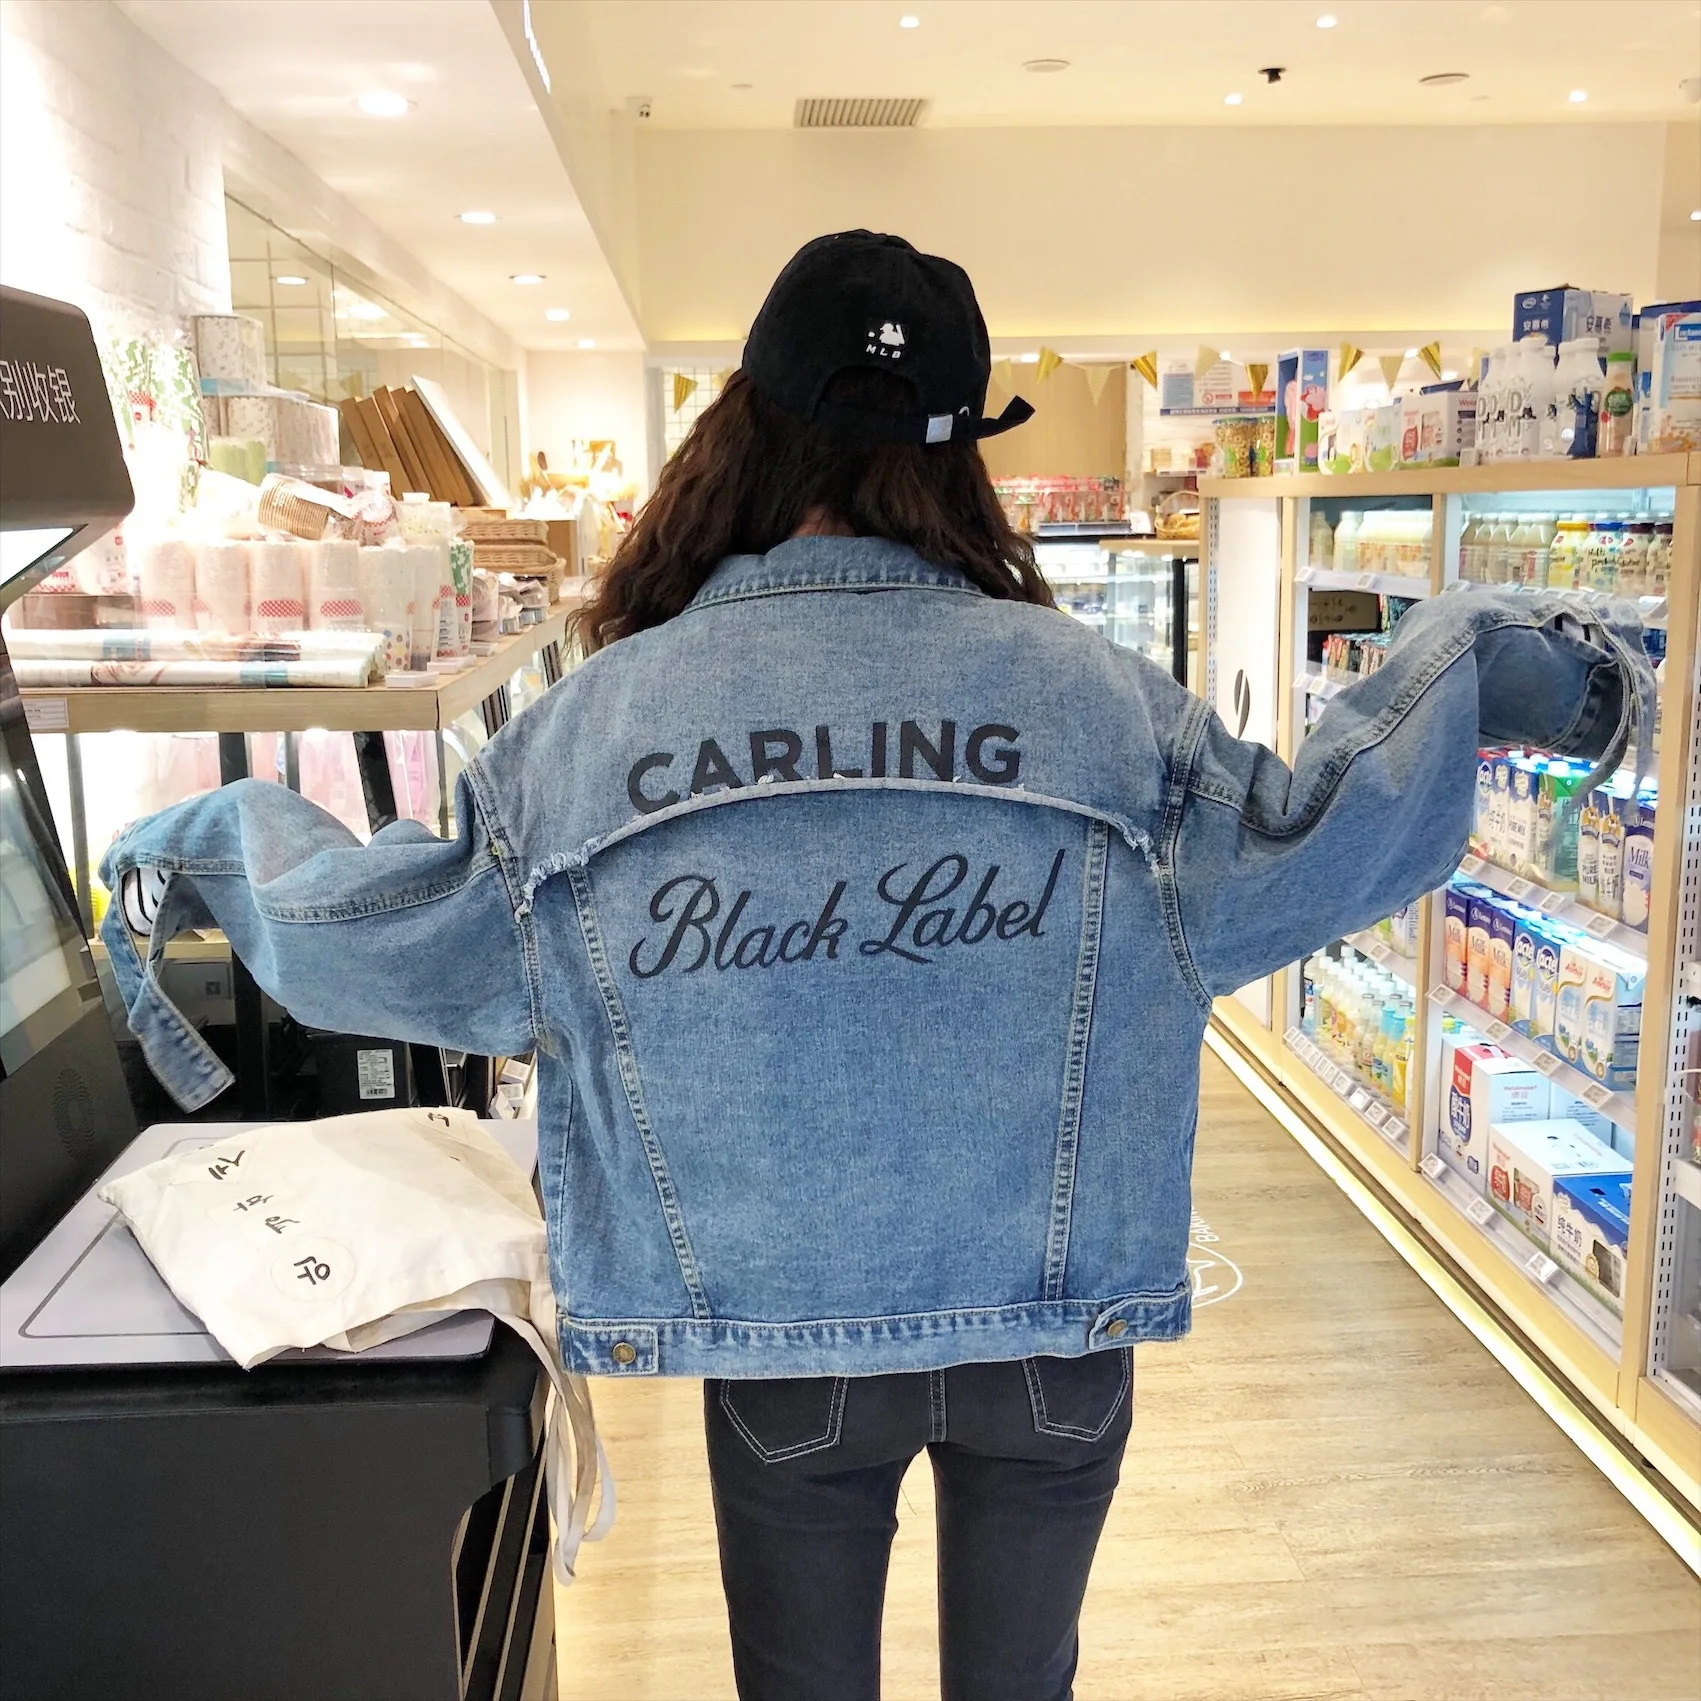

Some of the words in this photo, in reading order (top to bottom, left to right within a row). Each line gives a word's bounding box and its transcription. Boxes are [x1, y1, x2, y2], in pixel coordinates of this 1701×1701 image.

[866, 344, 901, 359] MLB
[0, 360, 81, 424] 别收银
[627, 720, 1022, 814] CARLING
[1629, 846, 1650, 870] Milk
[629, 874, 849, 979] Black
[858, 848, 1066, 965] Label
